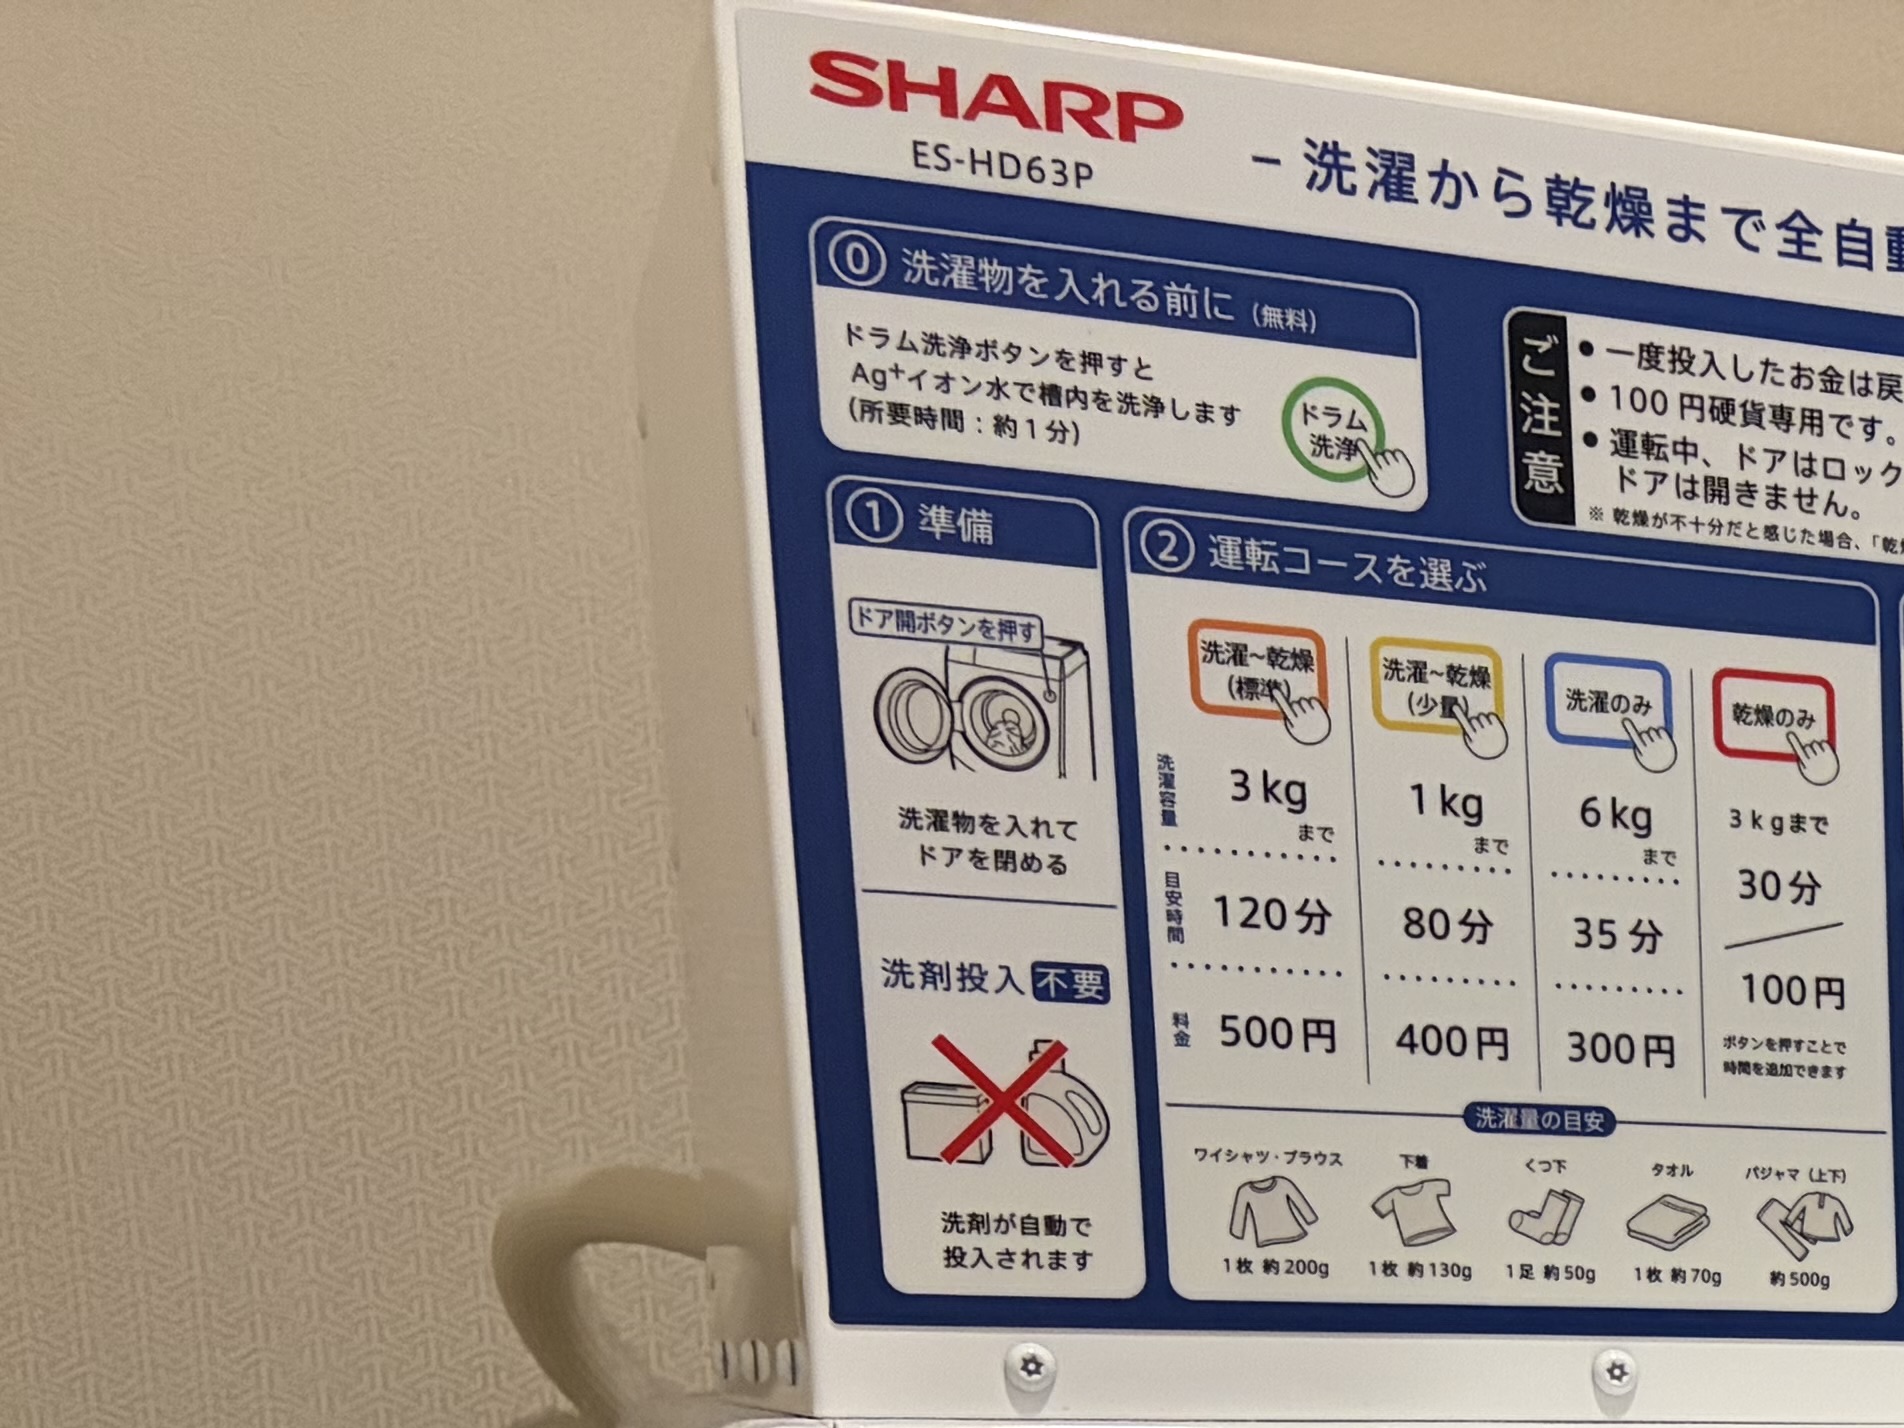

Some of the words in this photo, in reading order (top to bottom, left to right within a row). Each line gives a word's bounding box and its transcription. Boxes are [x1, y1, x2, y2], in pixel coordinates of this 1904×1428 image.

[807, 48, 1186, 144] SHARP
[910, 138, 1096, 191] ES-HD63P
[901, 247, 1235, 323] 洗濯物を入れる前に
[844, 322, 1156, 381] ドラム洗浄ボタンを押すと
[1300, 402, 1368, 435] ドラム
[1520, 335, 1565, 496] ご注意
[1309, 431, 1360, 461] 洗浄
[1614, 468, 1863, 523] ドアは開きません。
[918, 503, 994, 546] 準備
[1208, 533, 1488, 594] 運転コースを選ぶ
[856, 605, 1036, 644] ドア開ボタンを押す
[1565, 686, 1653, 718] 洗濯のみ
[1731, 701, 1816, 731] 乾燥のみ
[1156, 752, 1177, 828] 洗濯容量
[898, 805, 1080, 843] 洗濯物を入れて
[1298, 823, 1336, 844] まで
[918, 842, 1069, 877] ドアを閉める
[1473, 836, 1510, 856] まで
[1642, 847, 1678, 867] まで
[1738, 868, 1823, 907] 30分
[1214, 895, 1333, 936] 120分
[1403, 906, 1494, 946] 80分
[880, 957, 1026, 997] 洗剤投入
[1034, 965, 1106, 1001] 不要
[1741, 971, 1846, 1011] 100円
[1171, 1011, 1192, 1049] 料金
[1219, 1013, 1338, 1055] 500円
[1395, 1022, 1510, 1062] 400円
[1722, 1033, 1848, 1057] ボタンを押すことで
[1567, 1030, 1676, 1069] 300円
[1722, 1059, 1848, 1082] 時間を追加できます
[1475, 1105, 1605, 1134] 洗濯量の目安
[1399, 1153, 1429, 1170] 下着
[1525, 1158, 1567, 1174] くつ下
[1651, 1162, 1694, 1178] タオル
[940, 1209, 1093, 1239] 洗剤が自動で
[942, 1245, 1094, 1274] 投入されます
